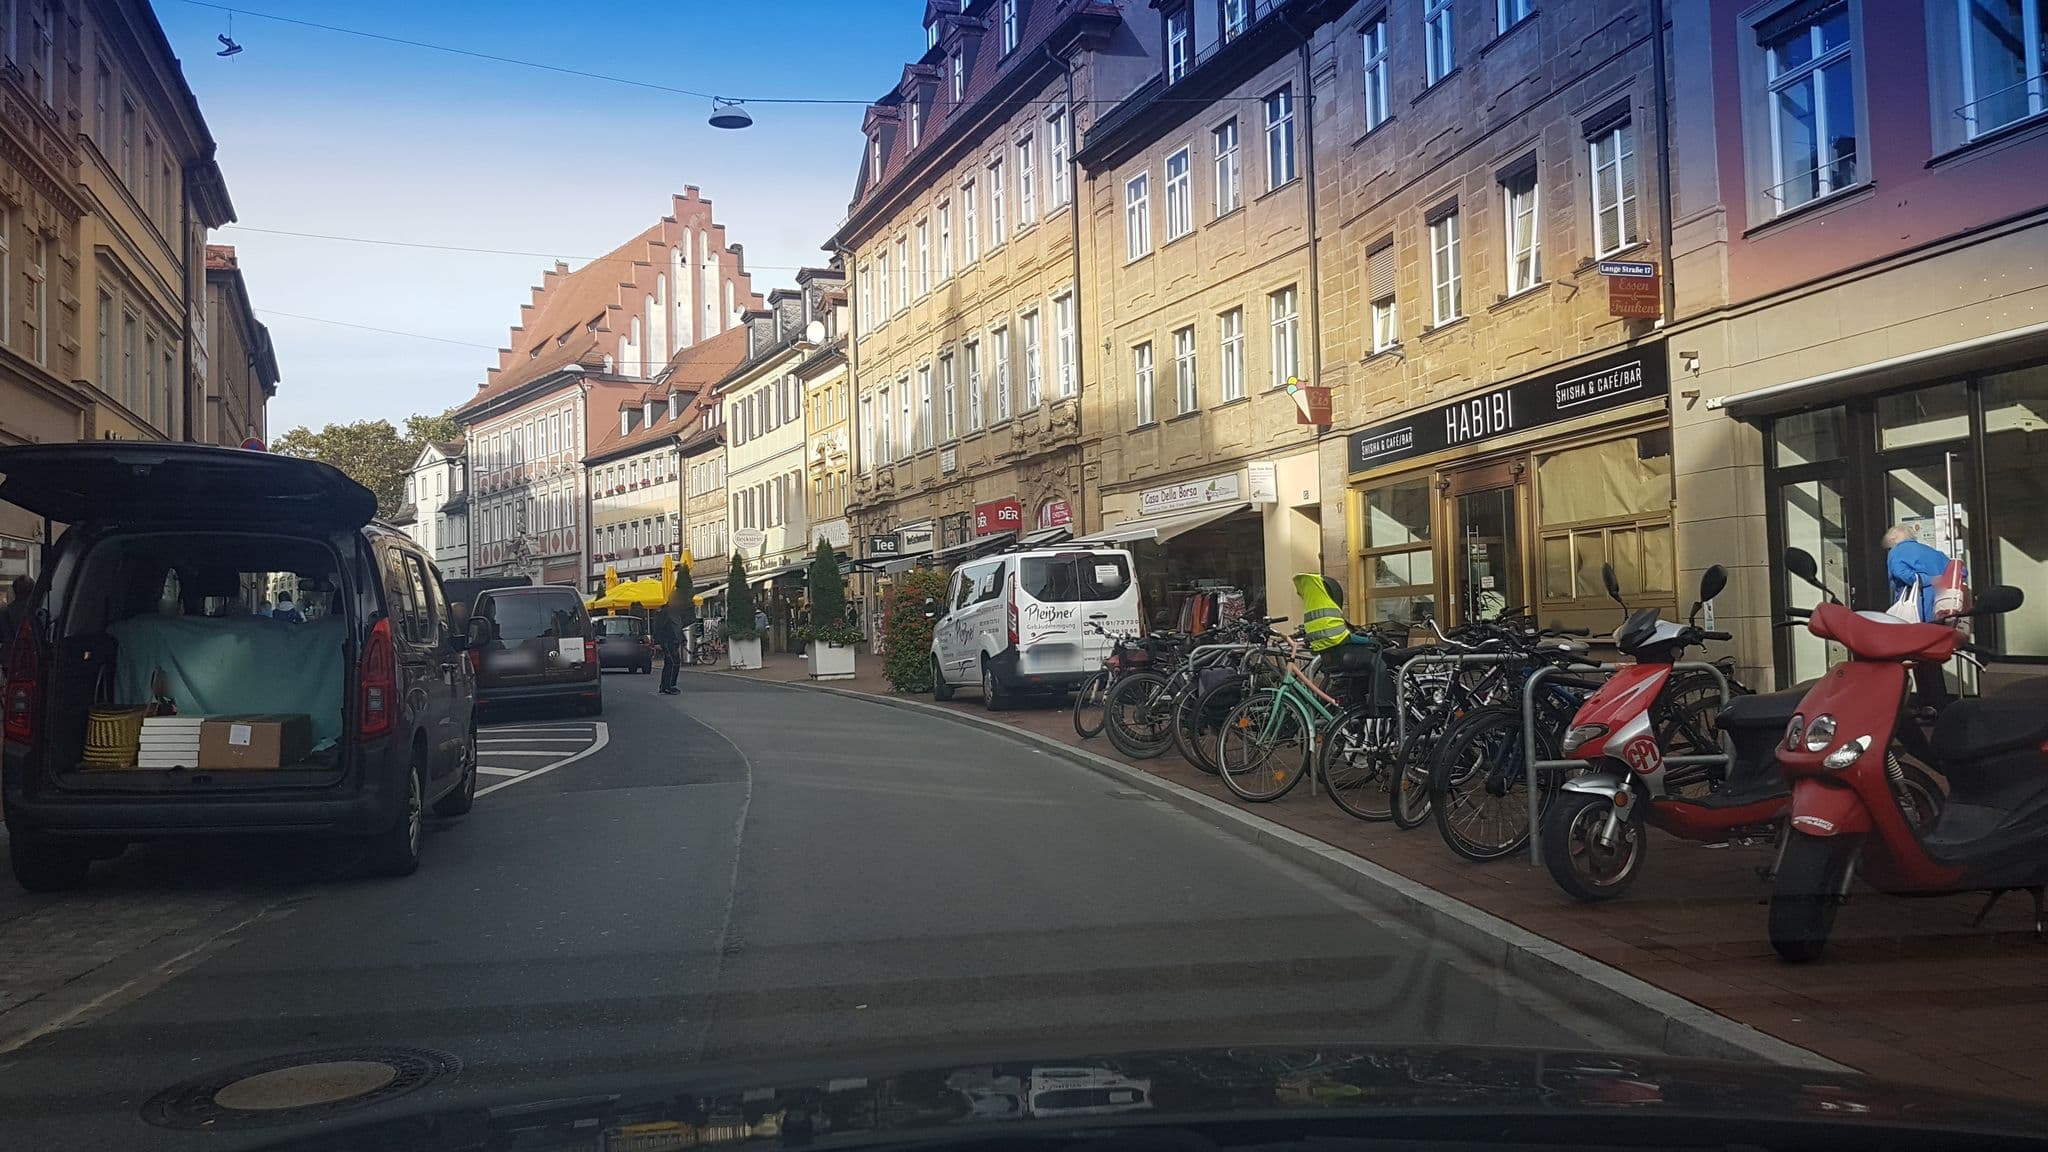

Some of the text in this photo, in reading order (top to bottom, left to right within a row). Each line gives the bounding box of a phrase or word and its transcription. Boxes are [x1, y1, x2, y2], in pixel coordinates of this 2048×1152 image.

[1601, 265, 1651, 274] Lange Straße 17
[1618, 277, 1649, 291] Essen
[1631, 292, 1639, 301] &
[1610, 300, 1655, 314] Trinken
[1555, 367, 1642, 404] SHISHA & CAFÉ/BAR
[1311, 390, 1329, 406] Eis
[1445, 390, 1513, 445] HABIBI
[1361, 440, 1380, 456] SHISHA
[1144, 493, 1159, 505] Casa
[1160, 488, 1177, 502] Della
[1178, 486, 1198, 499] Borsa
[998, 508, 1019, 520] DER
[874, 539, 895, 551] Tee
[1024, 603, 1077, 624] Pleißner
[1627, 740, 1658, 769] CPI
